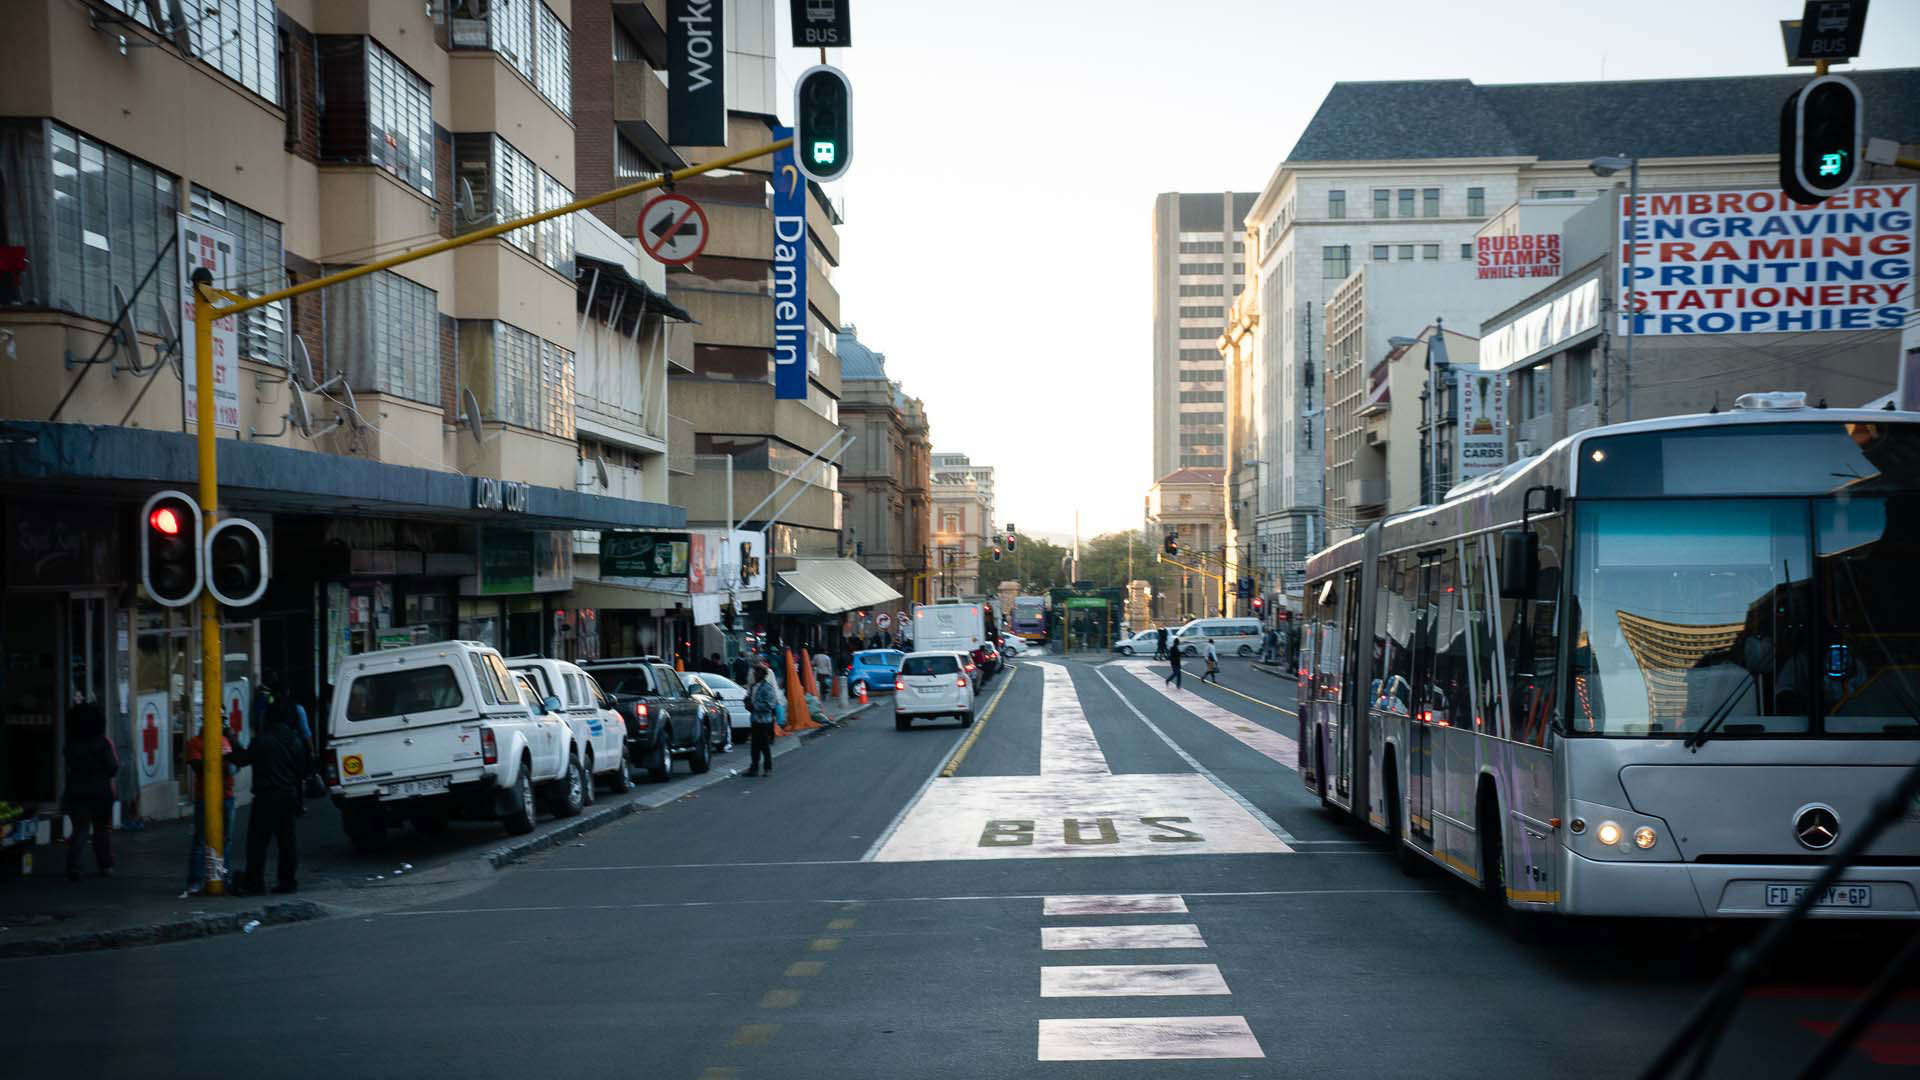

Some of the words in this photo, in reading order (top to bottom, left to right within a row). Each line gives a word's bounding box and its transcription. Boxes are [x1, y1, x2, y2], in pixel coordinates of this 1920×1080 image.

[678, 0, 713, 92] work
[805, 28, 838, 43] BUS
[1811, 38, 1848, 54] BUS
[1623, 186, 1912, 216] EMBROIERY
[1623, 211, 1912, 240] ENGRAVING
[1478, 234, 1560, 251] RUBBER
[1622, 234, 1911, 263] FRAMING
[1478, 249, 1561, 266] STAMPS
[1478, 265, 1560, 279] WHILE-U-WAIT
[1622, 258, 1911, 287] PRINTING
[775, 216, 806, 364] Damelin
[1623, 283, 1909, 312] STATIONERY
[1622, 306, 1909, 334] TROPHIES
[1464, 374, 1473, 436] TROPHIES
[1494, 374, 1503, 436] TROPHIES
[1463, 449, 1504, 458] CARDS
[978, 816, 1206, 848] BUS
[1770, 887, 1789, 904] FD
[1848, 888, 1867, 904] GP
